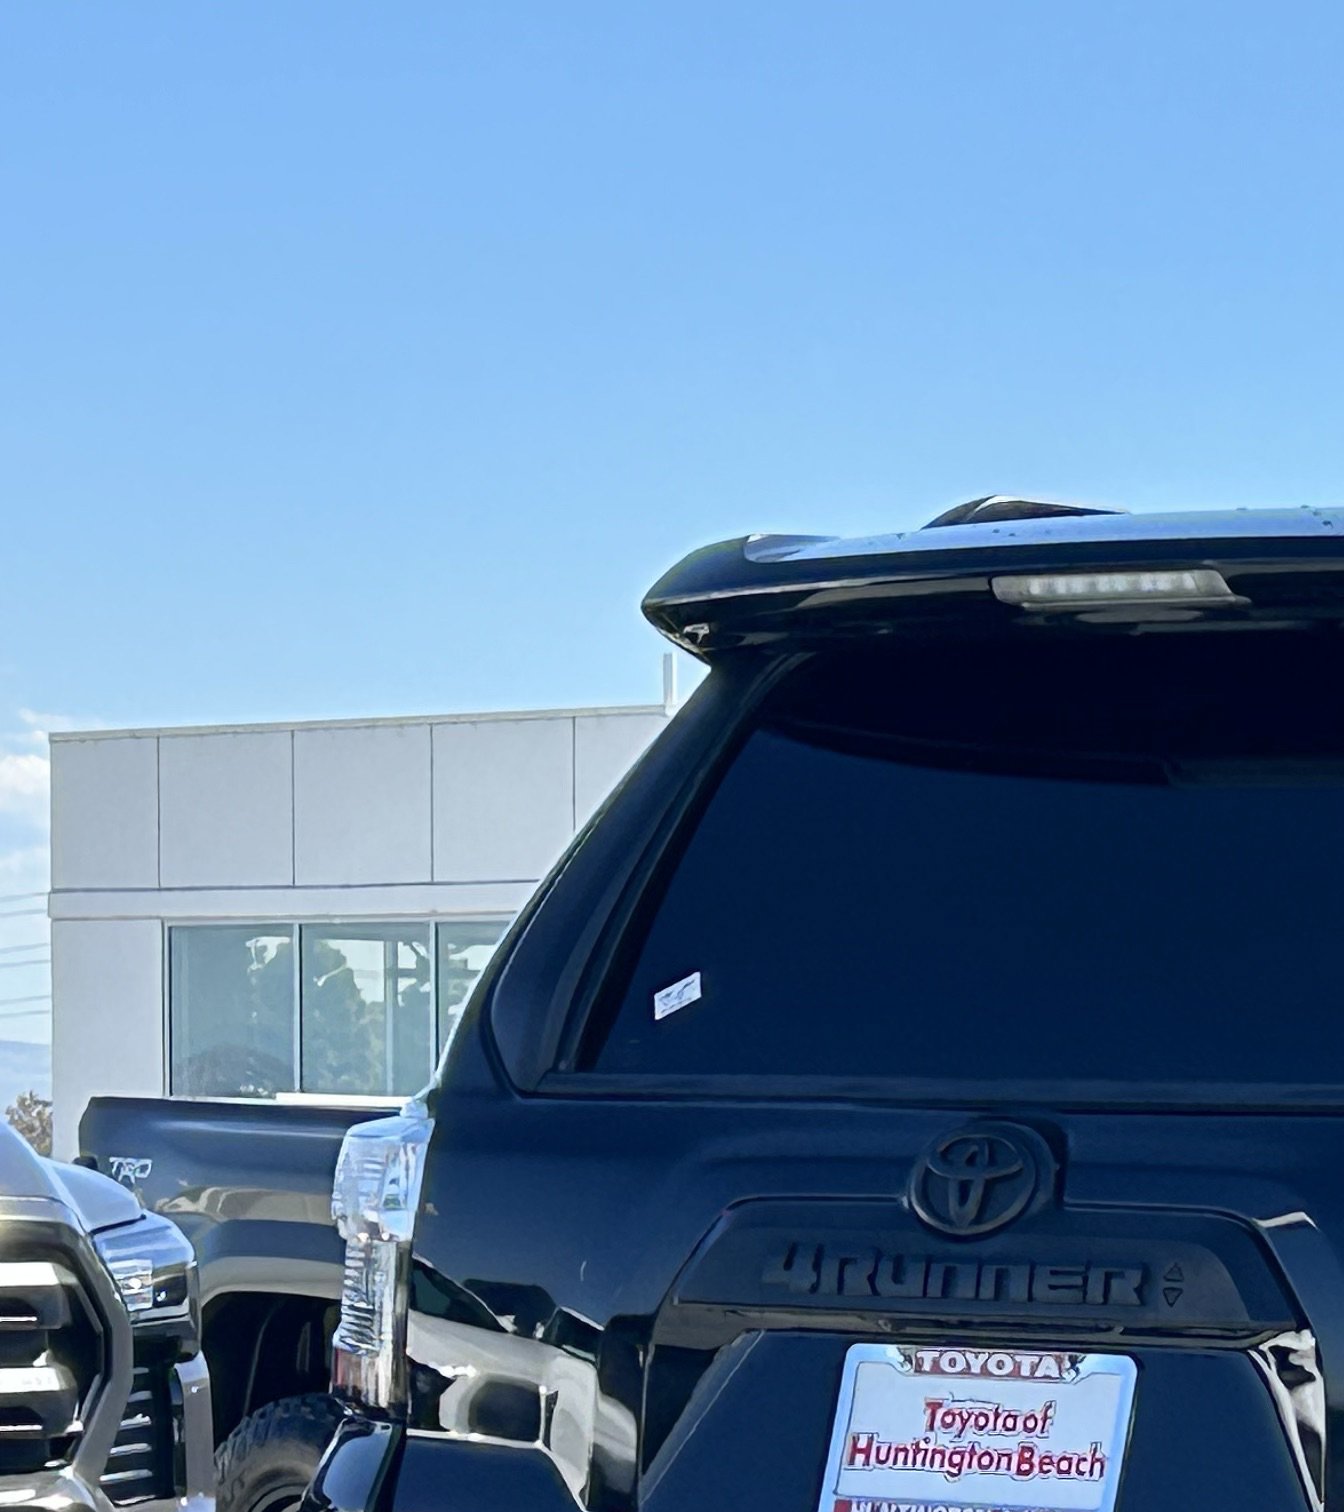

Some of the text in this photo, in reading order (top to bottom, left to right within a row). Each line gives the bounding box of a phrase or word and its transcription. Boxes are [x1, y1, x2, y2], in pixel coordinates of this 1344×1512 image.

[109, 1156, 152, 1184] TRD
[762, 1241, 1149, 1306] 4RUNNER
[915, 1349, 1060, 1379] TOYOTA
[924, 1398, 1053, 1438] Toyota of
[849, 1436, 1105, 1480] Huntington Beach
